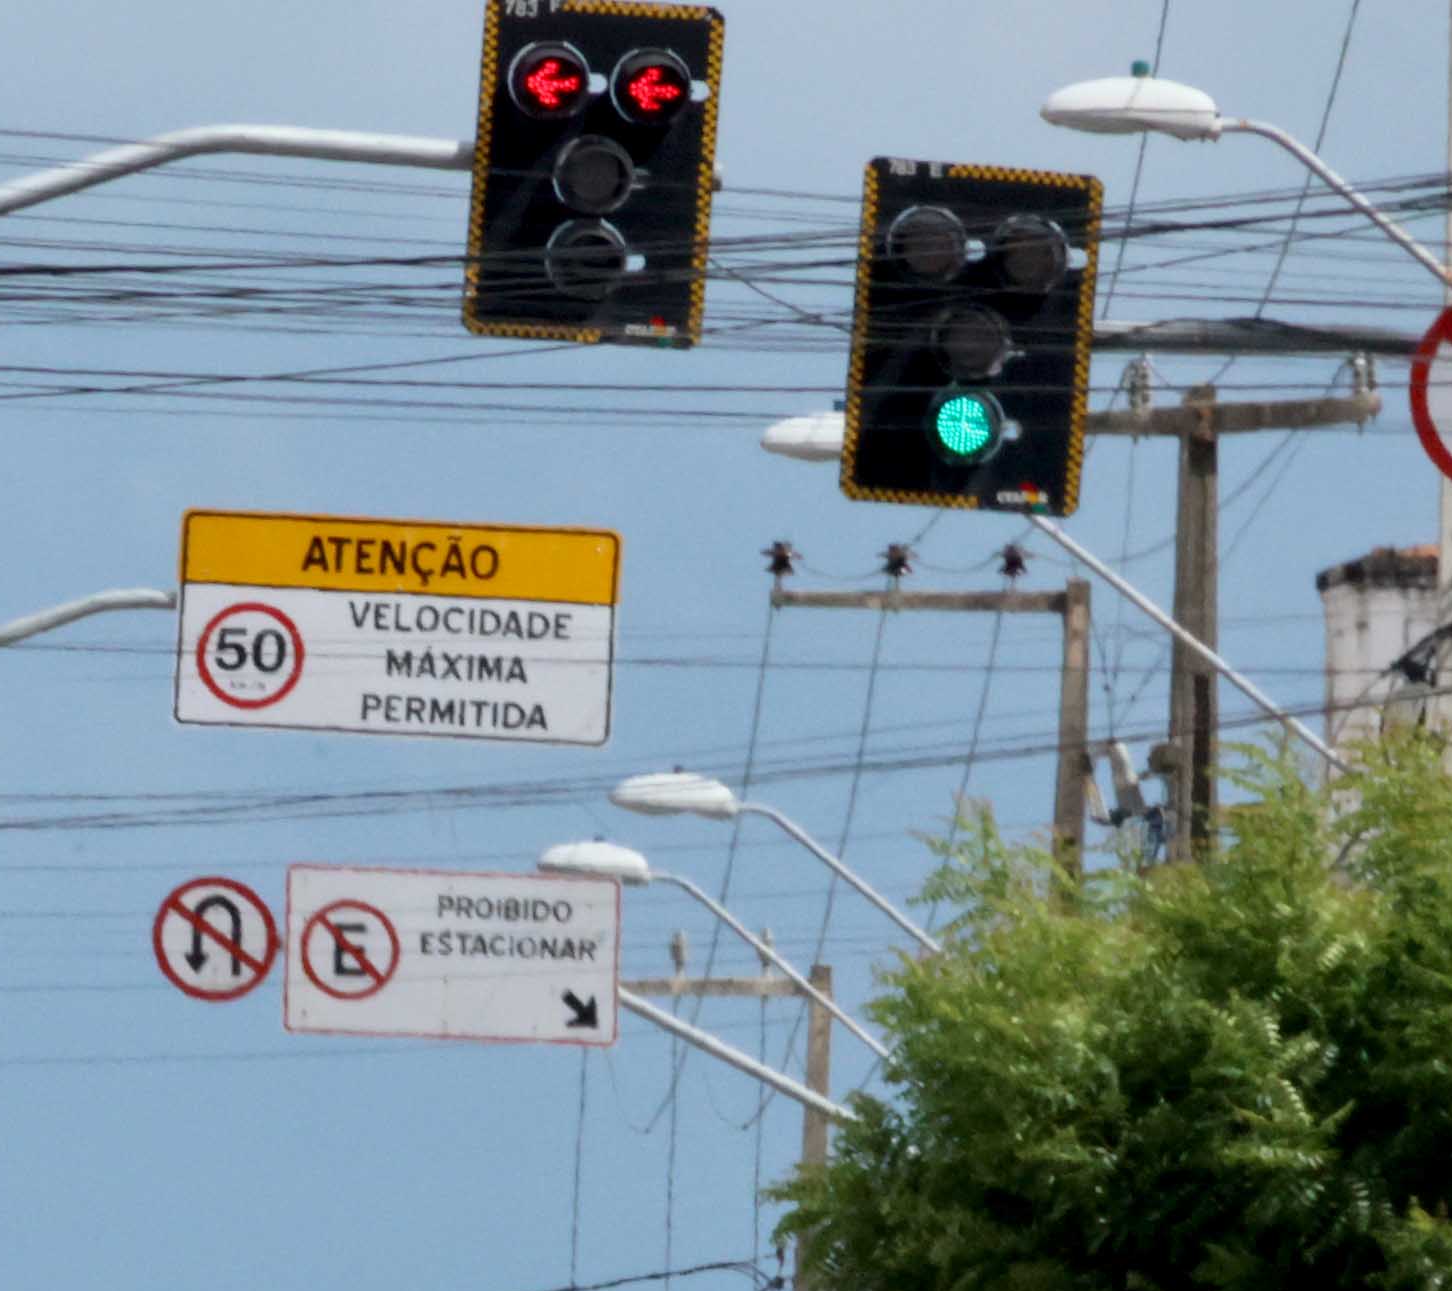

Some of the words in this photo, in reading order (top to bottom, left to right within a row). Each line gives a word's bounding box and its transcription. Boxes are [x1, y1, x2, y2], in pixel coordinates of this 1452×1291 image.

[300, 535, 500, 585] ATENÇÃO
[349, 601, 572, 641] VELOCIDADE
[214, 627, 287, 673] 50
[385, 646, 528, 685] MÁXIMA
[361, 694, 549, 731] PERMITIDA
[436, 894, 573, 922] PROIBIDO
[419, 931, 599, 962] ESTACIONAR
